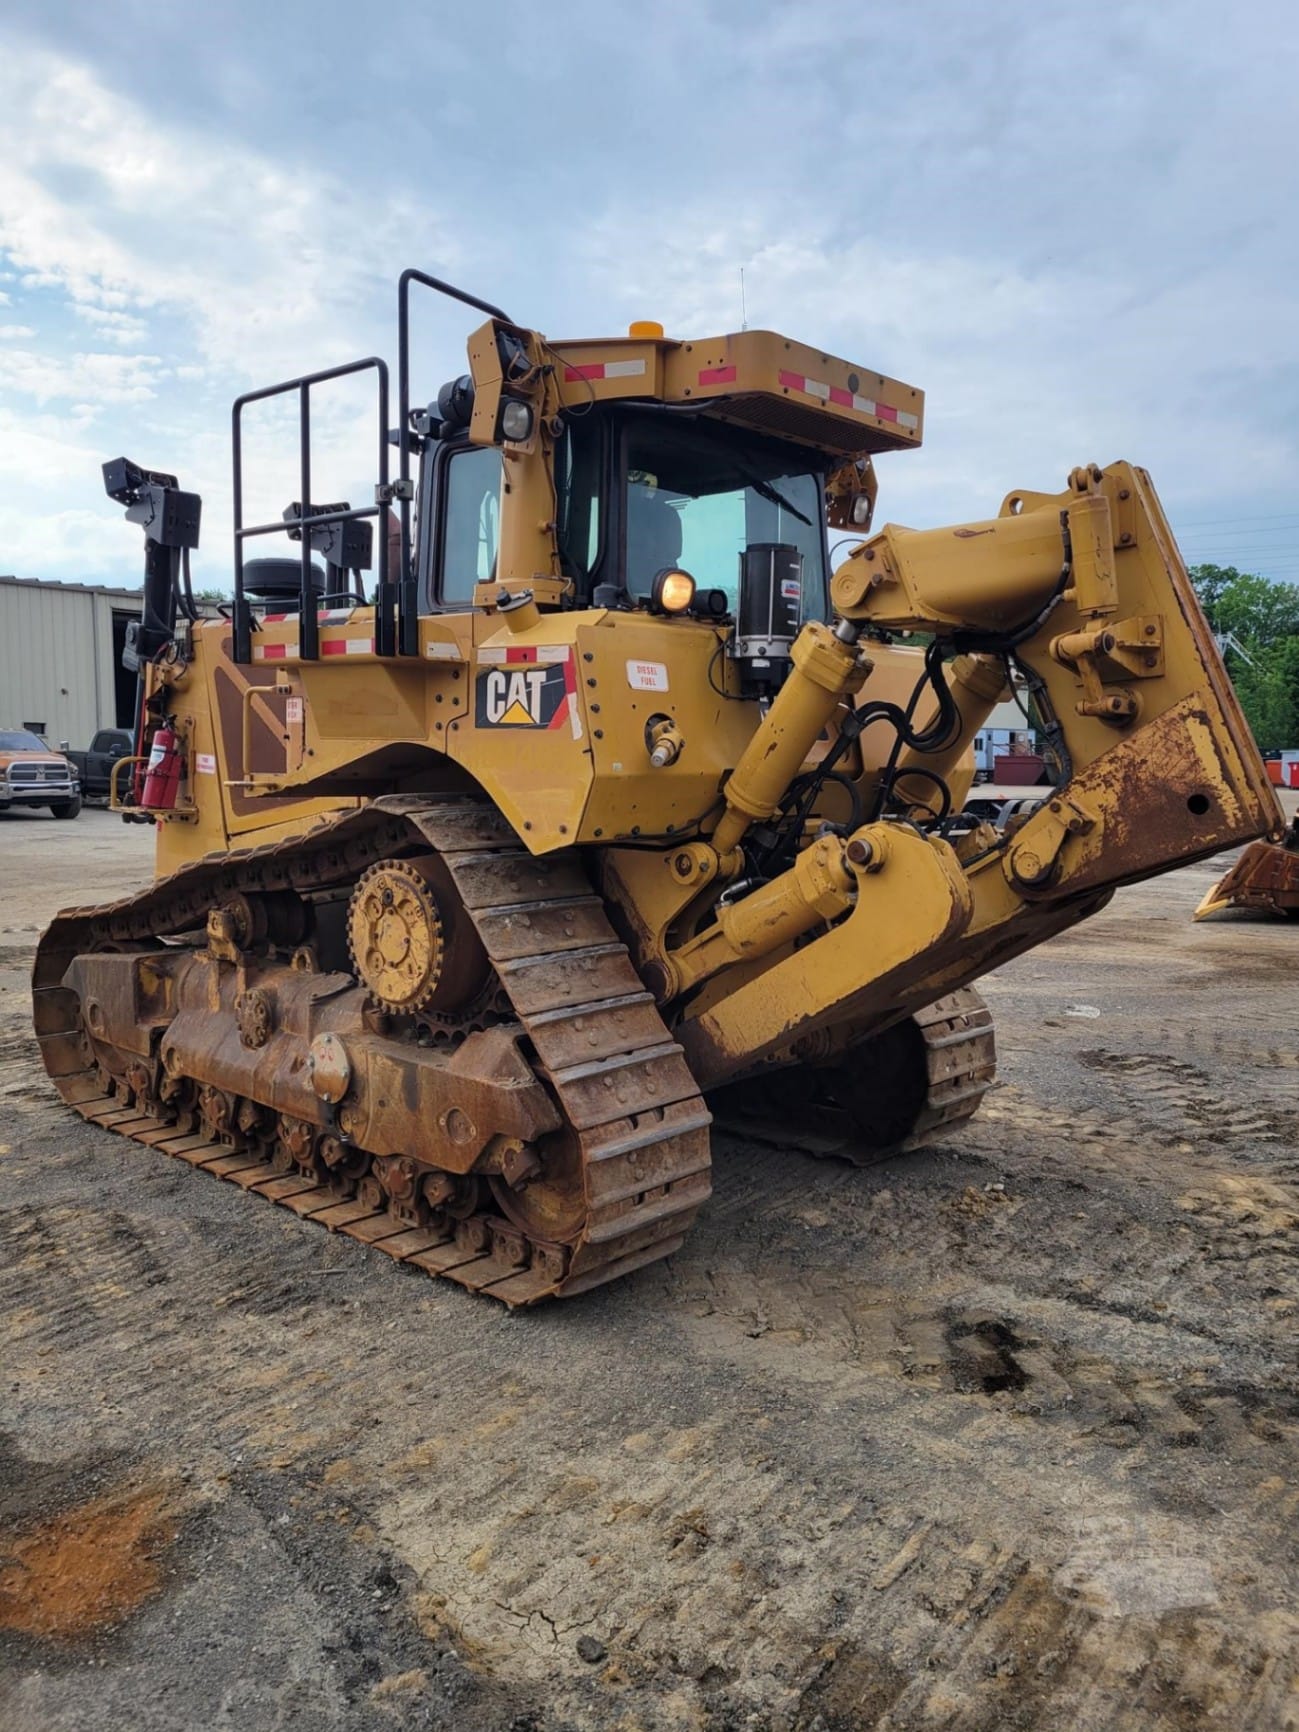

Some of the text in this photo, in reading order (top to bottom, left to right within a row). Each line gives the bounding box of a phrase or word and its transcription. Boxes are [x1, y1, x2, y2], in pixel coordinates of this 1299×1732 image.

[636, 665, 657, 676] DIESEL
[640, 676, 657, 686] FUEL
[486, 671, 547, 724] CAT
